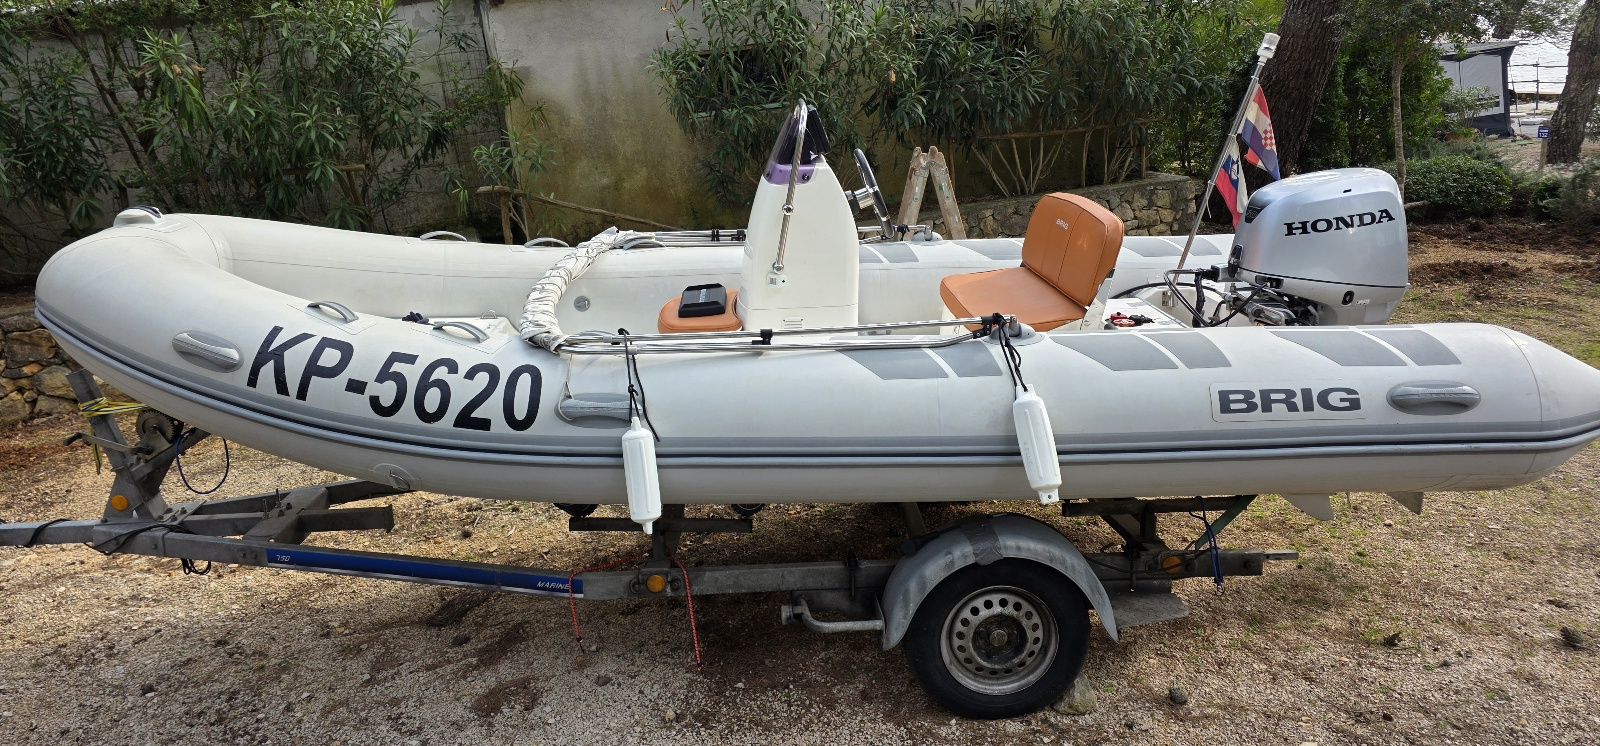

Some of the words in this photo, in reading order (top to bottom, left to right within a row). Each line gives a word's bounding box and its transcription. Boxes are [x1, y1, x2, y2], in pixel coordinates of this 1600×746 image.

[1284, 208, 1395, 236] HONDA
[246, 325, 543, 432] KP-5620
[1218, 387, 1361, 414] BRIG
[537, 581, 570, 590] MARINE
